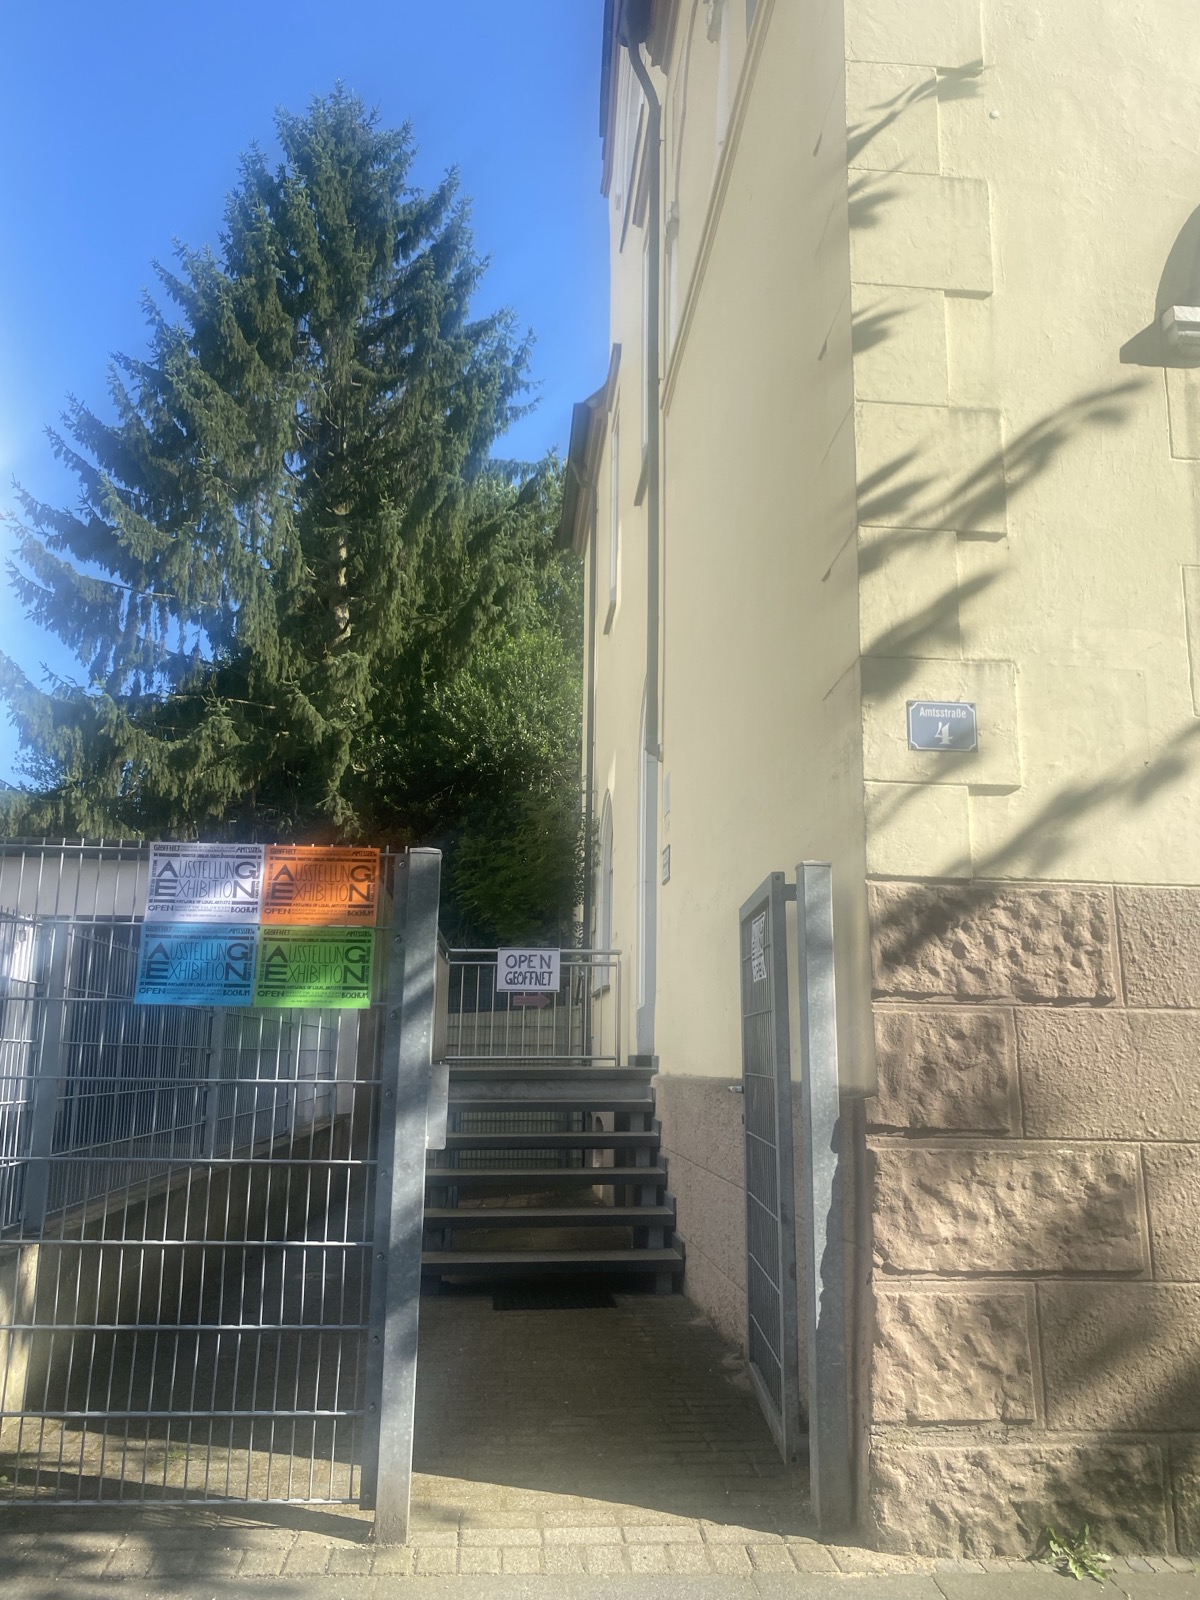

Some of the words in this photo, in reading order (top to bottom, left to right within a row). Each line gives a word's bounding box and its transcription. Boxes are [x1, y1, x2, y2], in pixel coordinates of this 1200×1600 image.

[919, 706, 967, 719] Amtsstraße
[934, 721, 954, 745] 4
[156, 860, 257, 880] AUSSTELLUNG
[273, 863, 372, 883] AUSSTELLUNG
[154, 878, 256, 899] EXHIBITION
[271, 882, 371, 902] EXHIBITION
[148, 904, 174, 912] OPEN
[230, 906, 258, 914] BOCHUM
[264, 907, 291, 915] OPEN
[347, 909, 374, 917] BOCHUM
[147, 941, 249, 961] AUSSTELLUNG
[266, 944, 366, 964] AUSSTELLUNG
[145, 960, 247, 981] EXHIBITION
[505, 954, 552, 970] OPEN
[264, 963, 365, 984] EXHIBITION
[222, 989, 250, 997] BOCHUM
[257, 989, 285, 998] OPEN
[341, 991, 369, 999] BOCHUM
